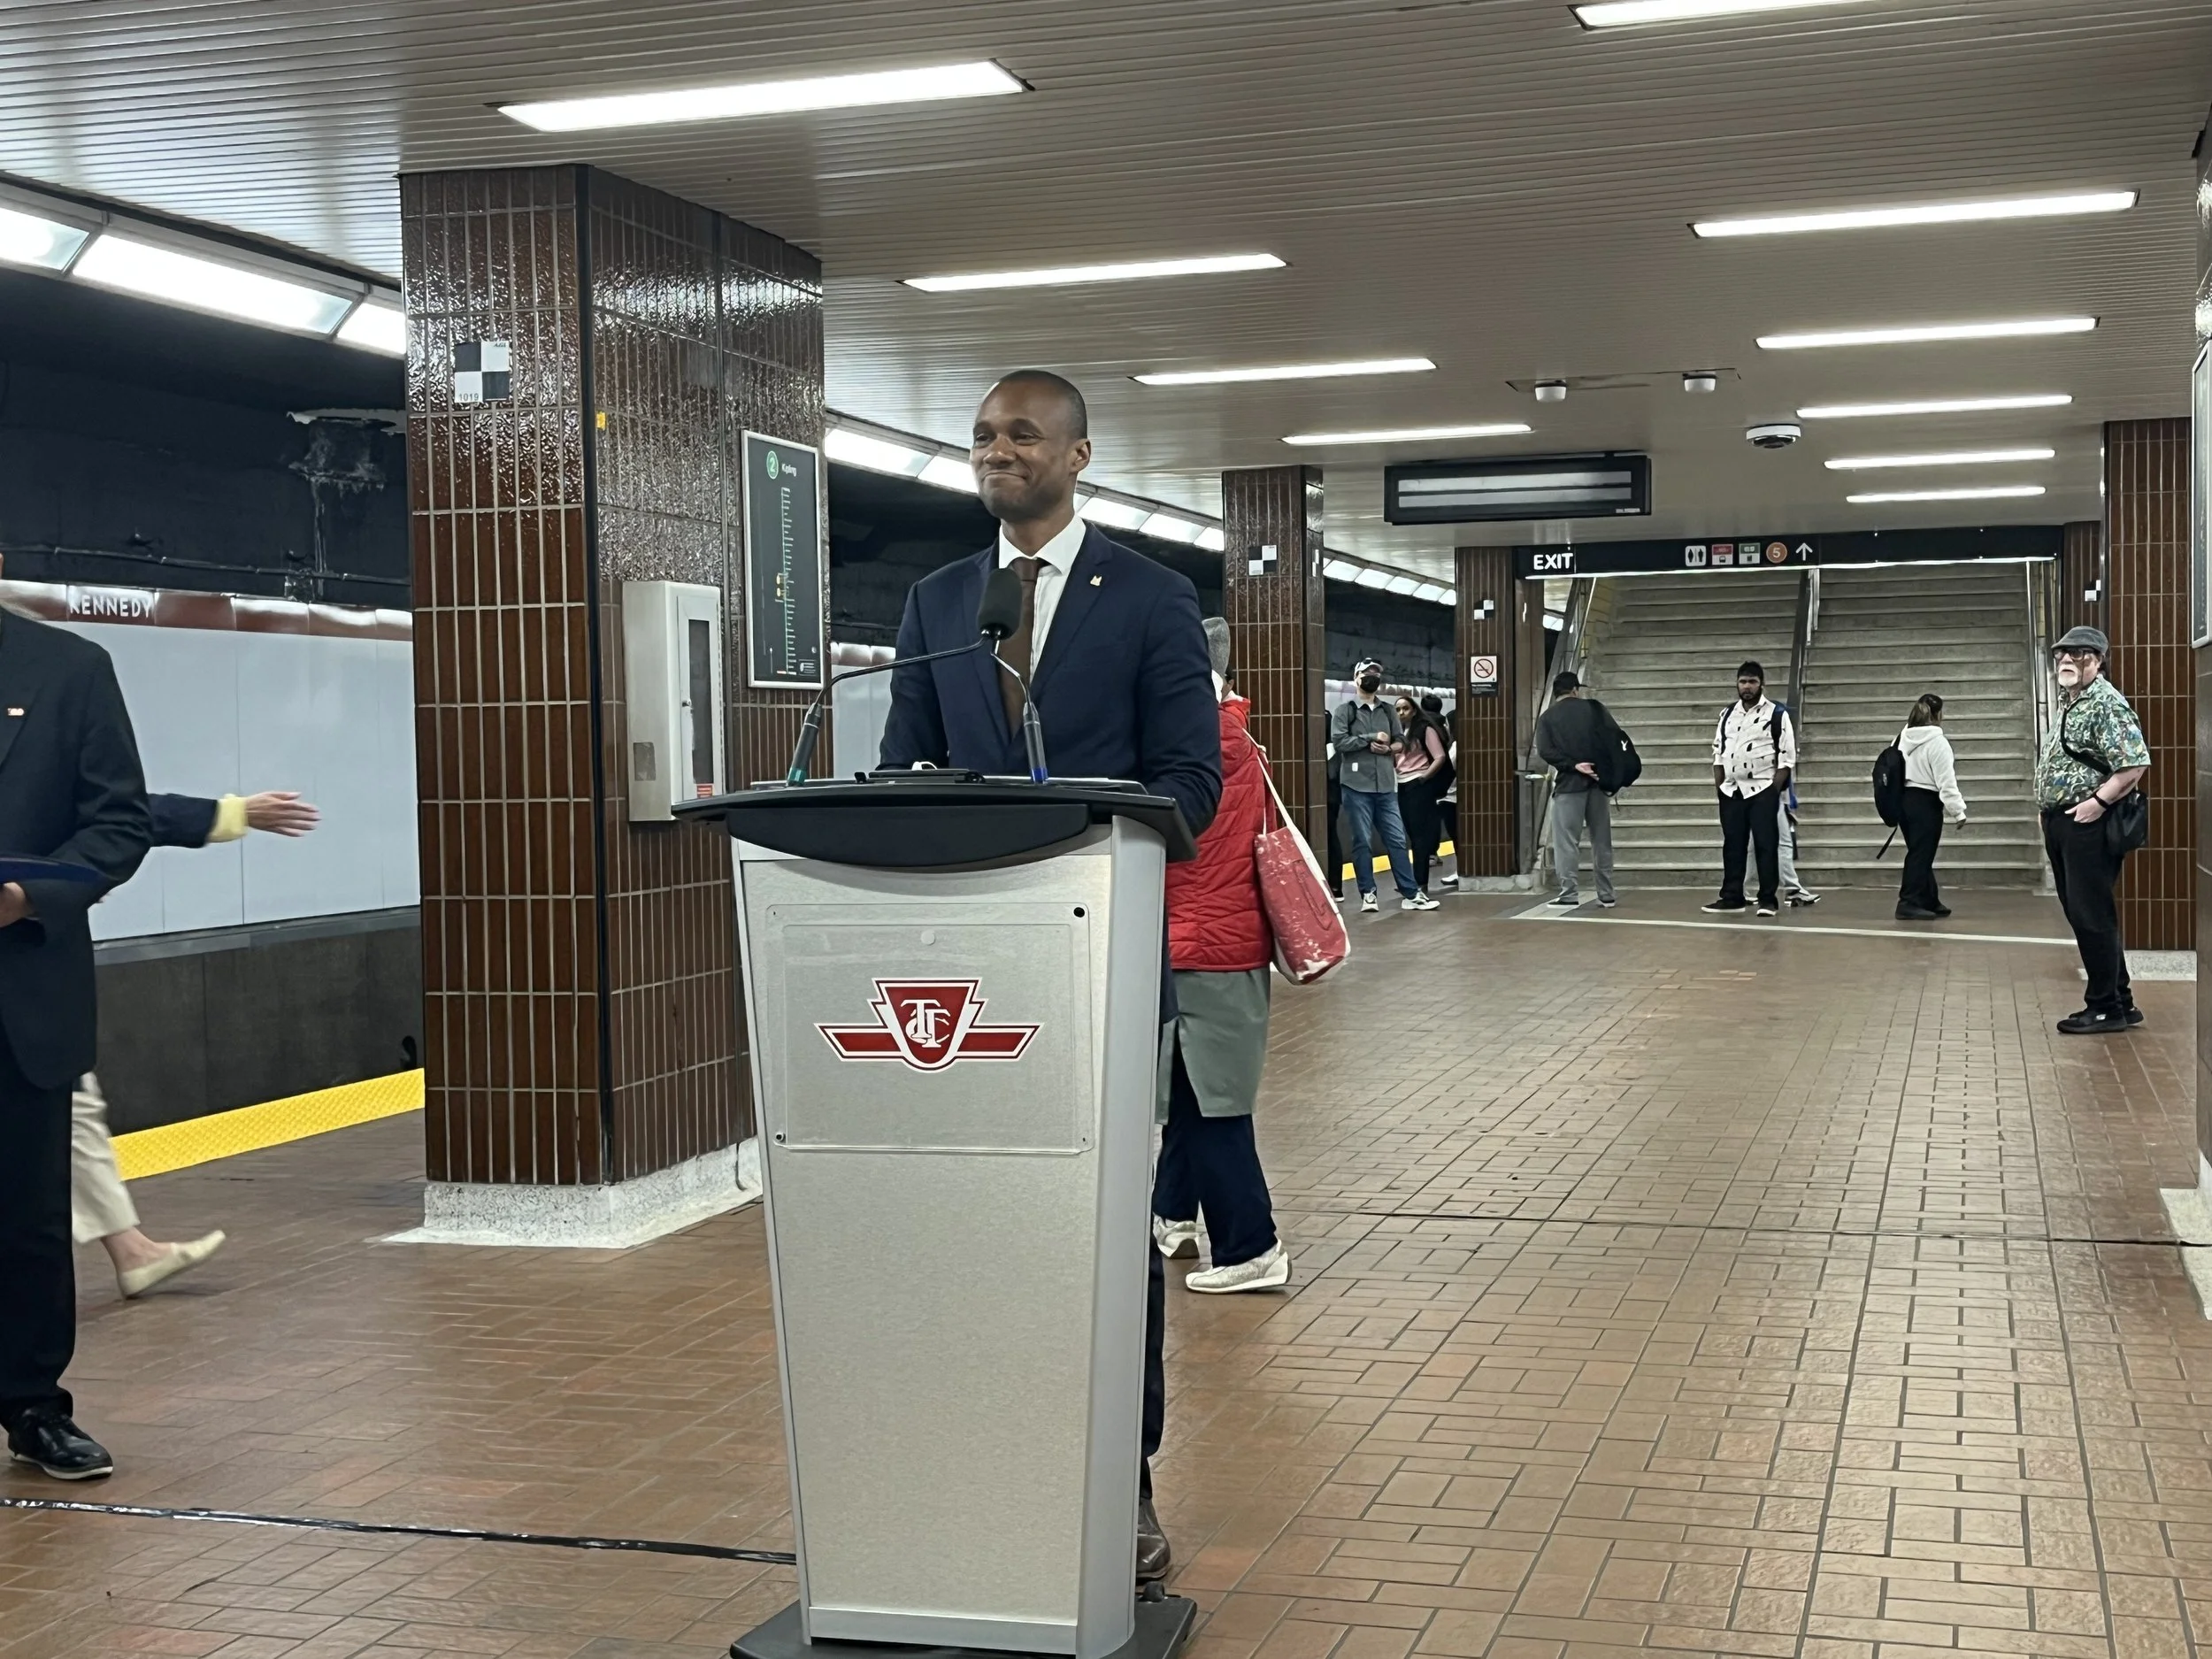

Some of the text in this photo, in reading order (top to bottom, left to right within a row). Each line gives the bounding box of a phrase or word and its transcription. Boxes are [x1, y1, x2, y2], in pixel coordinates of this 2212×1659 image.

[769, 457, 776, 472] 2
[1533, 552, 1573, 570] EXIT
[1772, 547, 1780, 558] 5
[70, 592, 151, 618] KENNEDY
